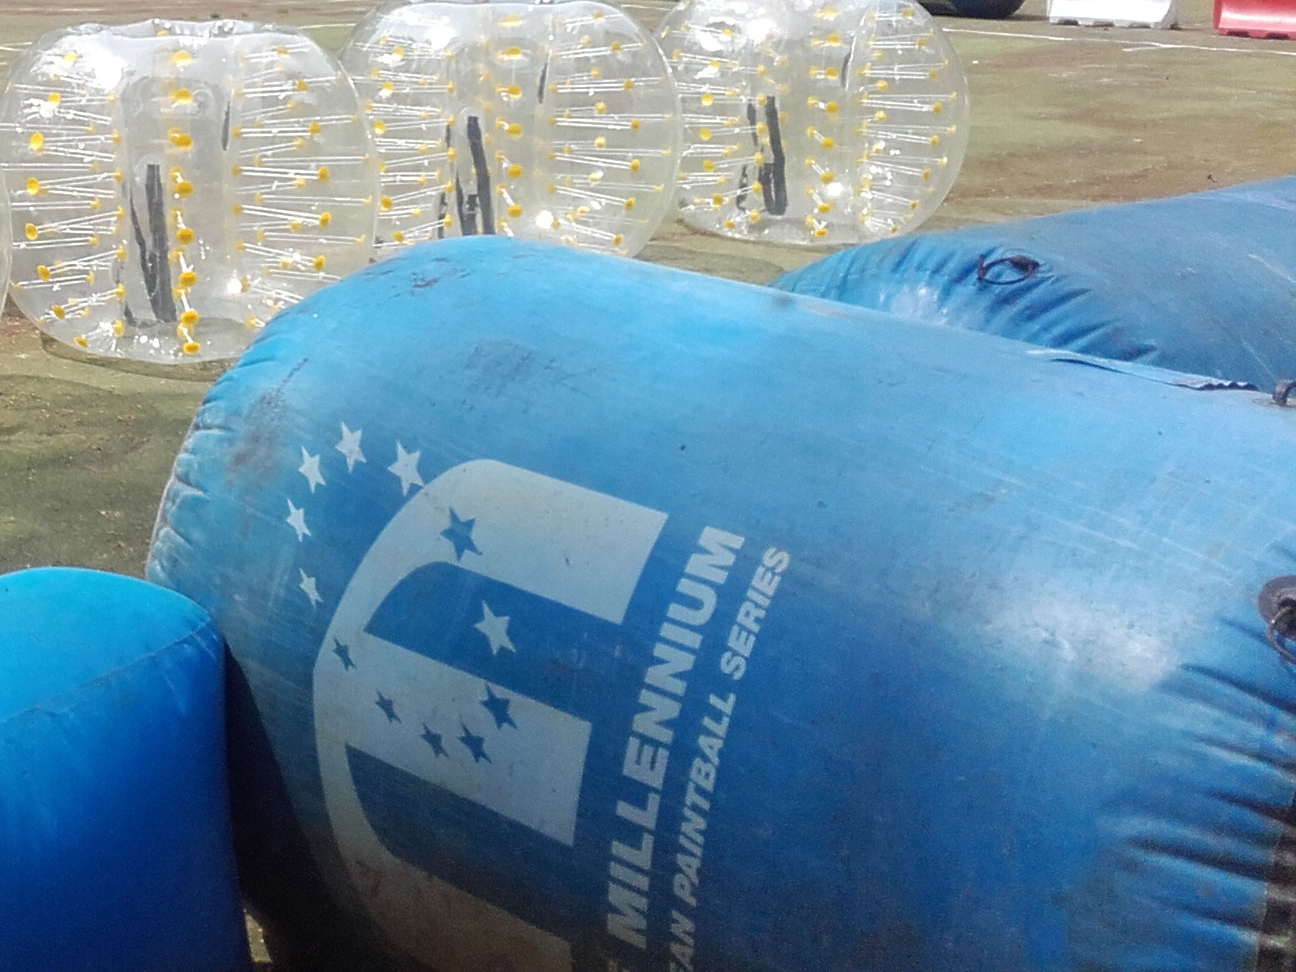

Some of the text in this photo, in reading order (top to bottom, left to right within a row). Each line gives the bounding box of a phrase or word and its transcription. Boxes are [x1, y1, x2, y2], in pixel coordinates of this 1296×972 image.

[607, 525, 746, 950] MILLENNIUM
[672, 691, 737, 908] PAINTBALL
[720, 546, 792, 681] SERIES
